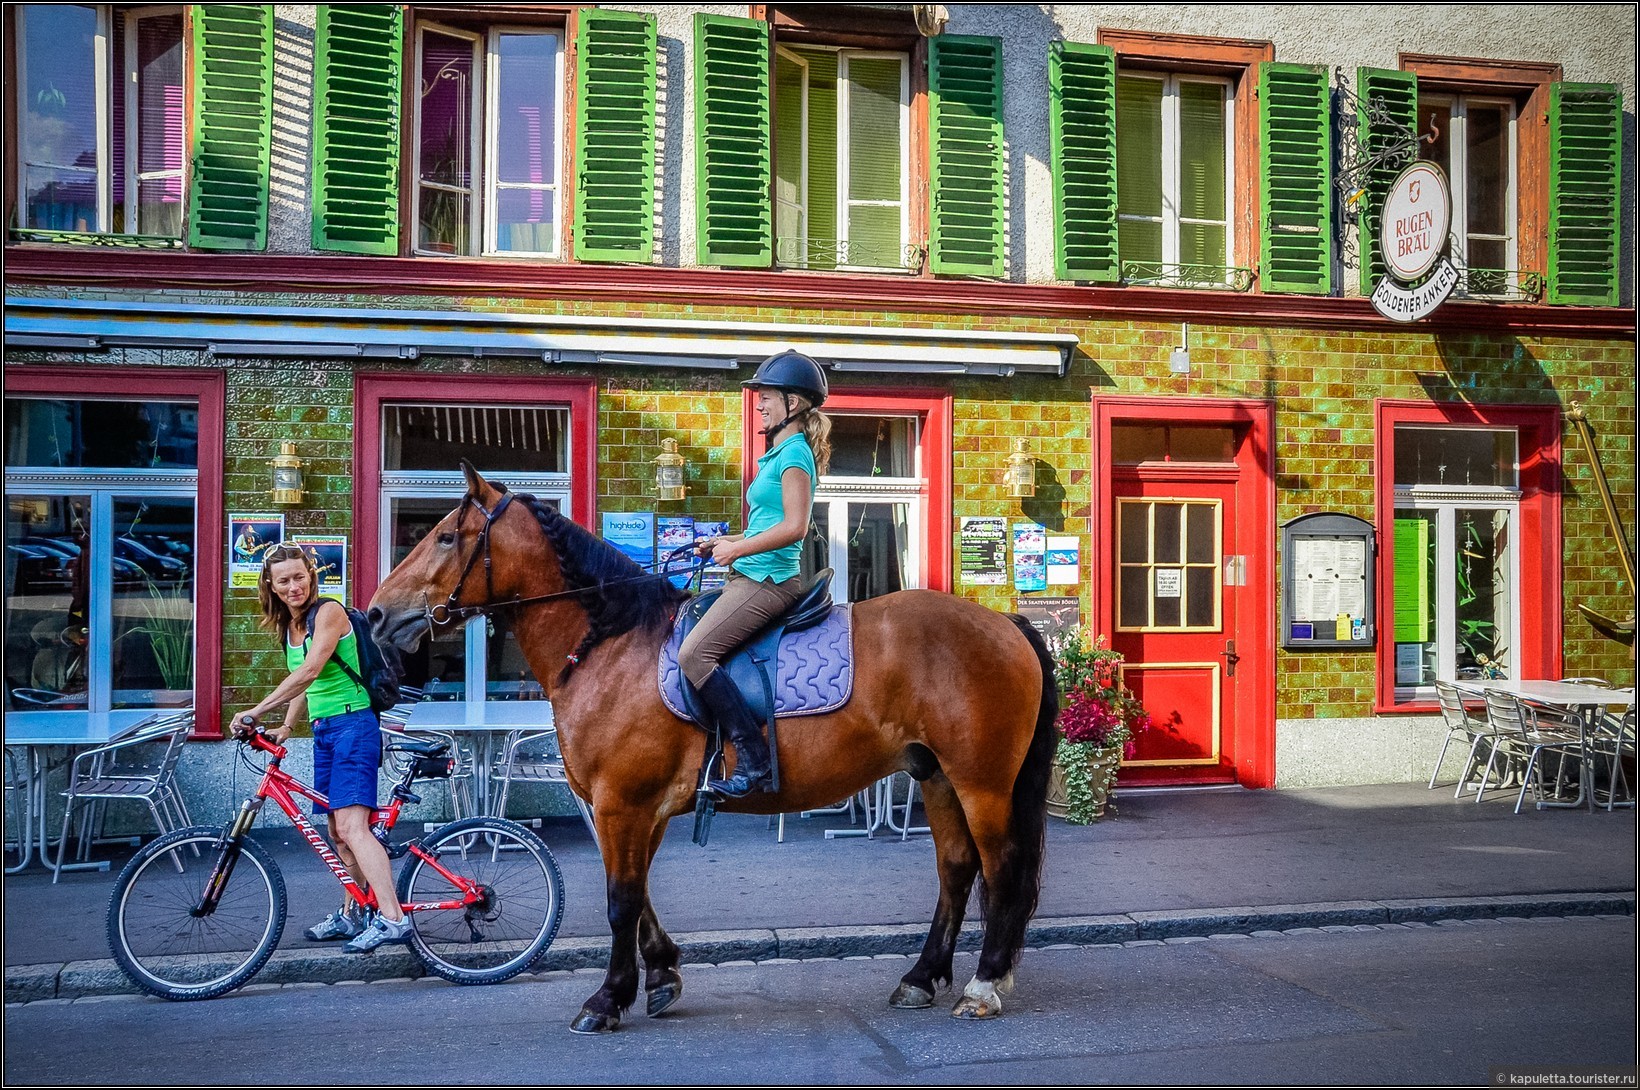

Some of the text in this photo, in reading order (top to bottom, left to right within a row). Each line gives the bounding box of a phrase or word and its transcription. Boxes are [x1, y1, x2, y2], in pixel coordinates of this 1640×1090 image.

[1396, 209, 1433, 237] RUGEN
[1398, 231, 1430, 257] BRÄU
[1377, 266, 1453, 313] GOLDENER ANKER
[291, 813, 355, 885] SPECIALIZED
[413, 902, 441, 910] FSR
[169, 986, 207, 994] SMART
